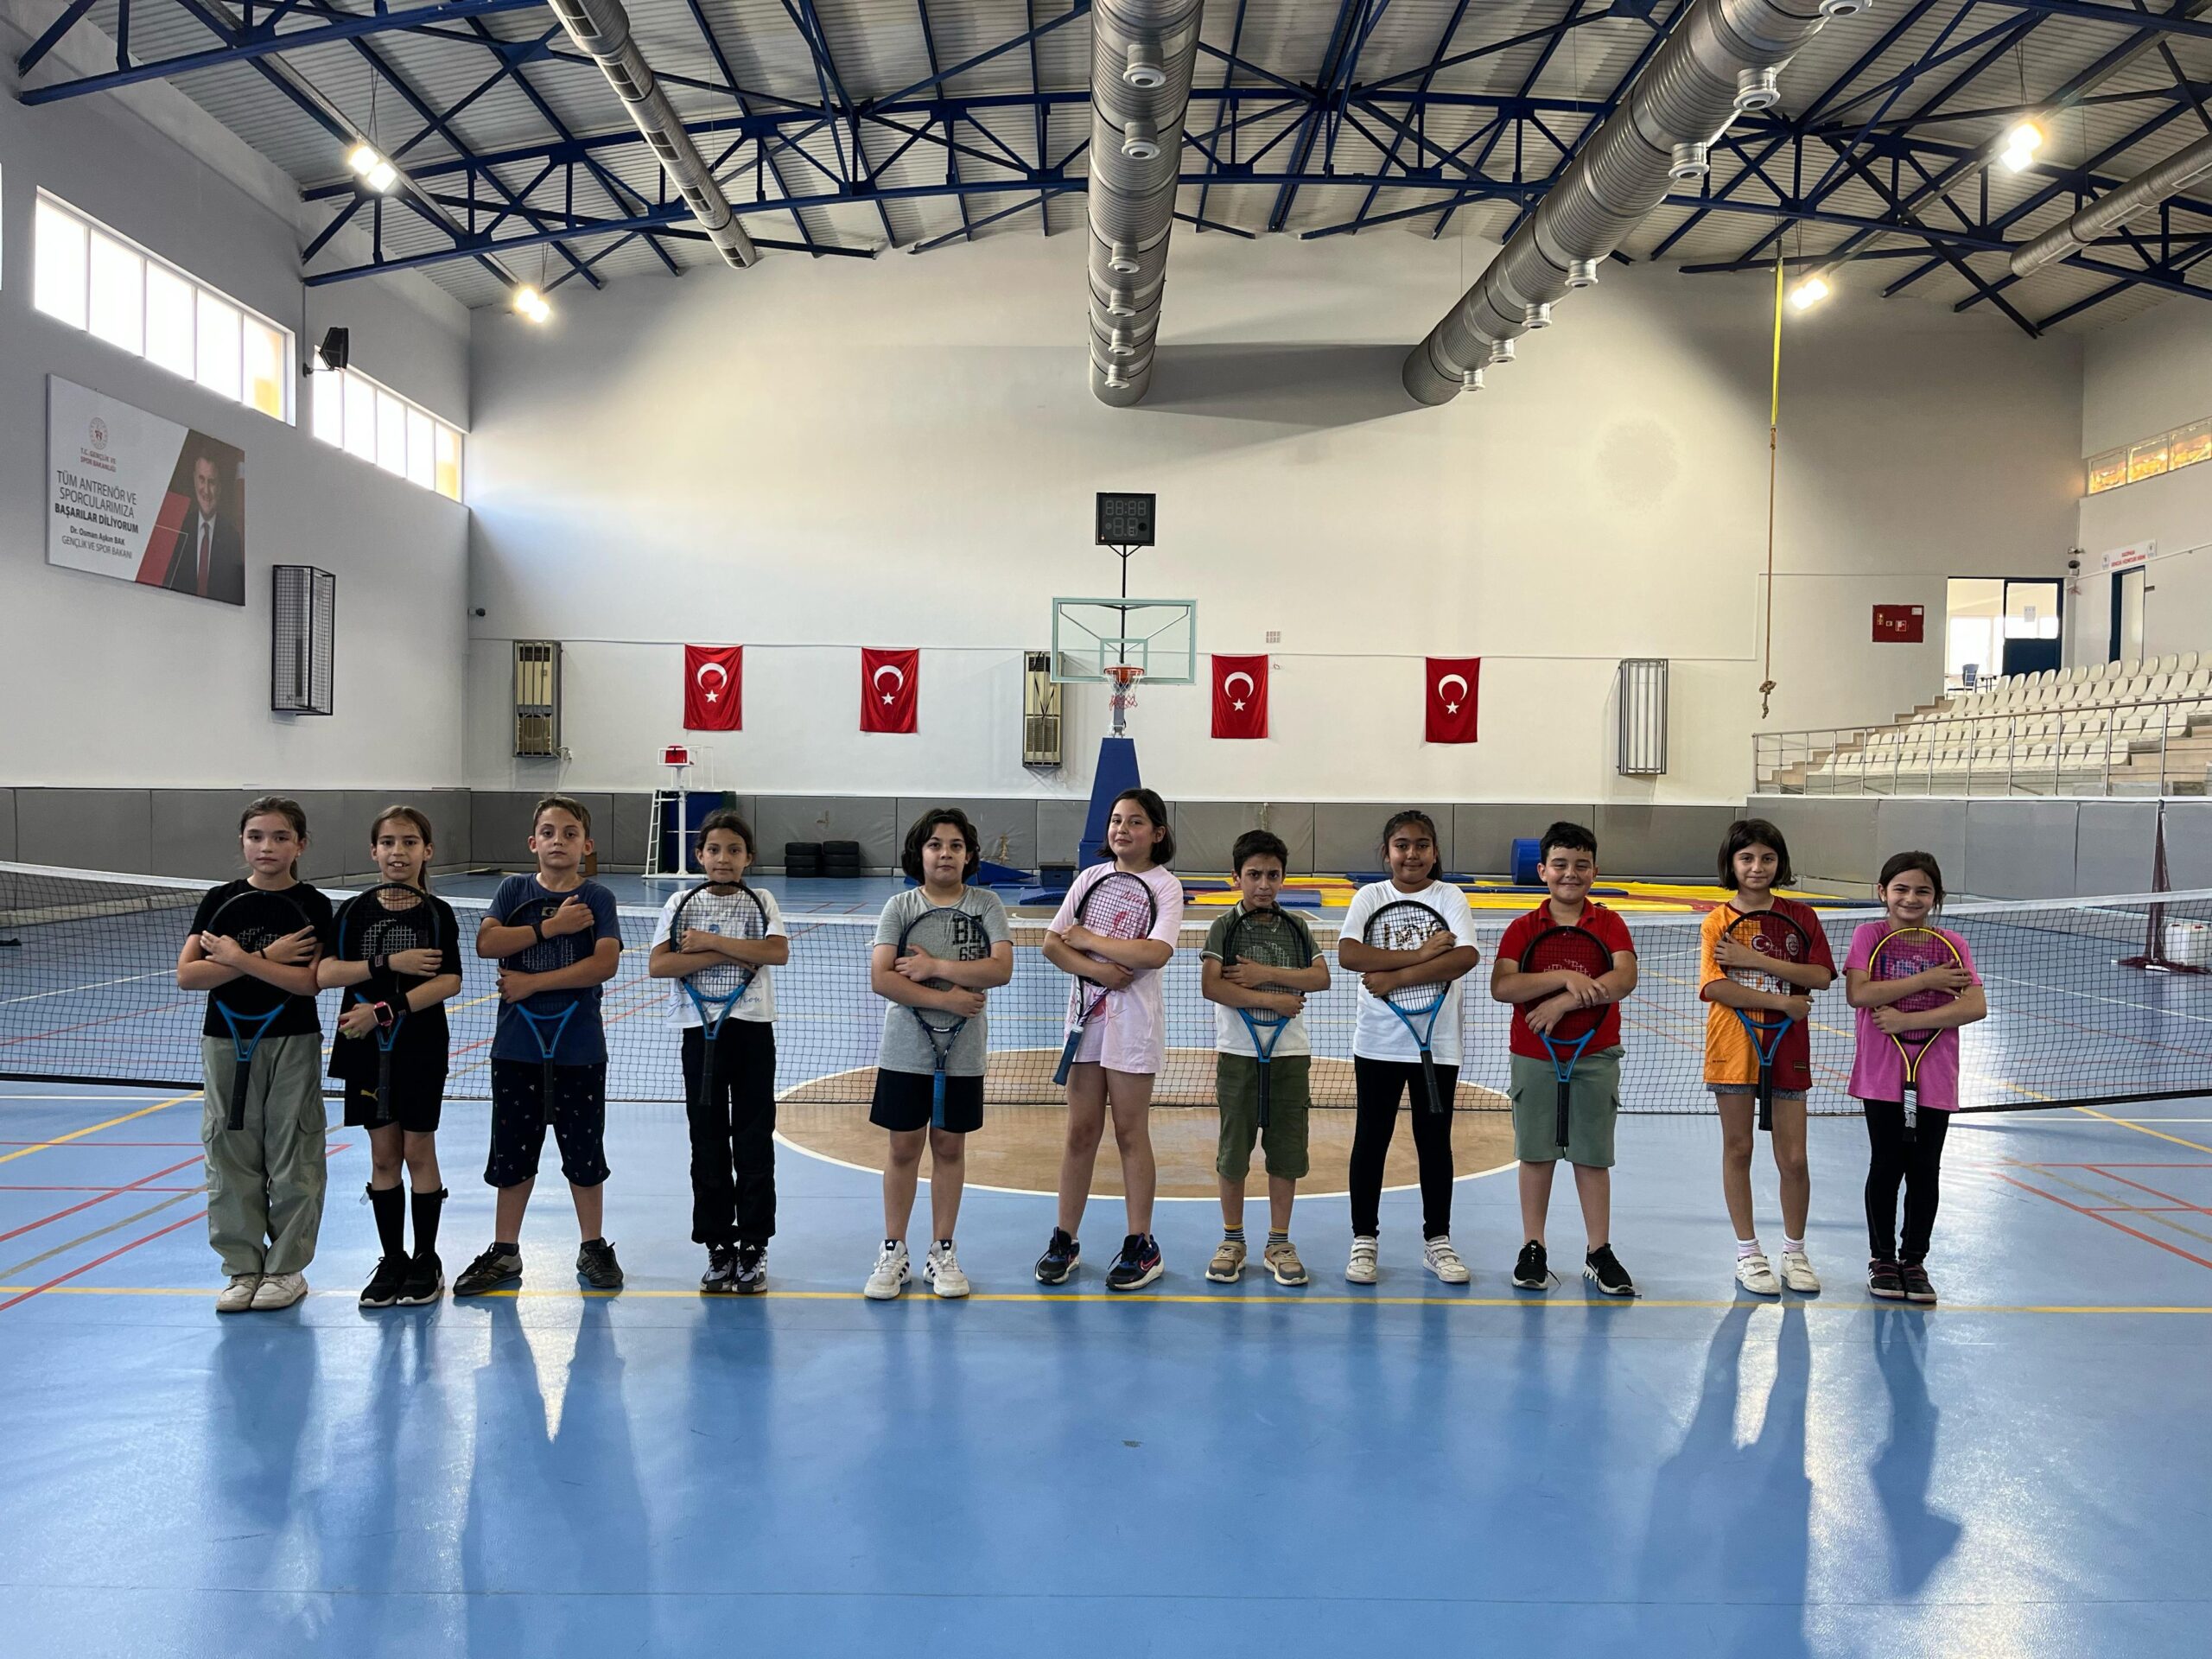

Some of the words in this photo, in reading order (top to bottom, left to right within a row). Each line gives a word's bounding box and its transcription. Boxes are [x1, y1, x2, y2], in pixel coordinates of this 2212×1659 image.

[57, 470, 78, 488] TÜM
[79, 477, 125, 502] ANTRENÖR
[127, 491, 137, 505] VE
[60, 486, 135, 519] SPORCULARIMIZA
[54, 503, 98, 524] BAŞARILAR
[99, 514, 138, 534] DİLİYORUM
[61, 535, 86, 549] GENÇLİK
[88, 541, 95, 551] VE
[96, 543, 111, 554] SPOR
[112, 546, 132, 559] BAKANI
[79, 528, 98, 540] Osman
[99, 532, 114, 543] Aşkın
[114, 536, 125, 546] BAK
